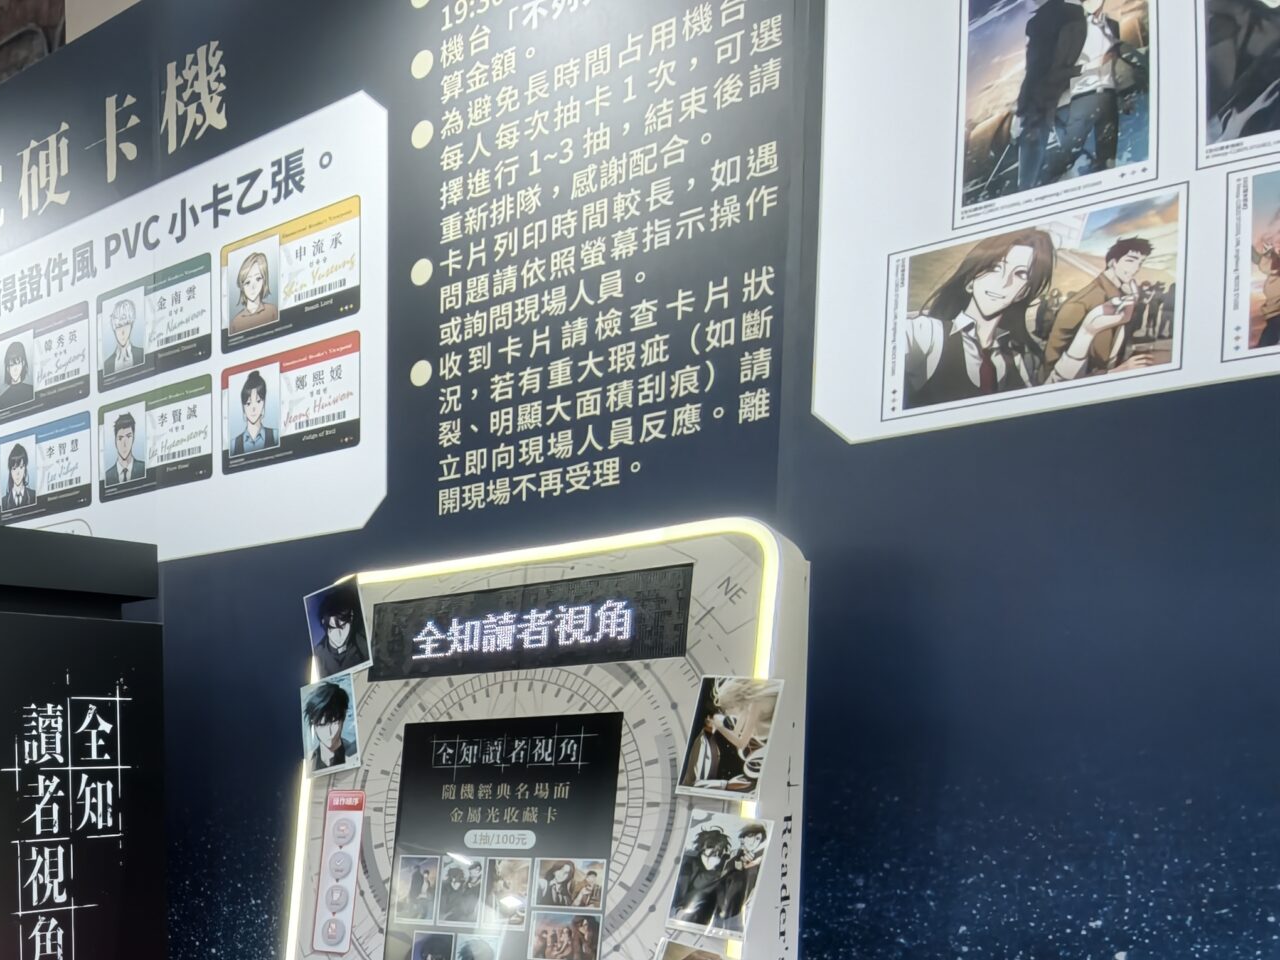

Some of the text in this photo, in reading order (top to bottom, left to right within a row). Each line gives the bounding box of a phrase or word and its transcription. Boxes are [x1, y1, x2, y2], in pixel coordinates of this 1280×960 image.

[440, 0, 746, 139] 為避免長時間占用機台
[440, 47, 535, 103] 算金額。
[440, 132, 713, 244] 重新排隊，感謝配合。
[440, 141, 779, 278] 卡片列印時間較長，如遇
[104, 214, 161, 269] PVC
[440, 185, 779, 314] 問題請依照螢幕指示操作
[439, 270, 646, 348] 或詢問現場人員。
[439, 266, 775, 380] 收到卡片請檢查卡片狀
[438, 390, 771, 482] 立即向現場人員反應。離
[438, 457, 643, 516] 開現場不再受理。
[411, 600, 634, 660] 全知讀者視角
[436, 738, 579, 765] 全知讀者視角
[441, 781, 571, 800] 隨機經典名場面
[449, 806, 559, 824] 金屬光收藏卡
[471, 832, 528, 846] 1抽/100元
